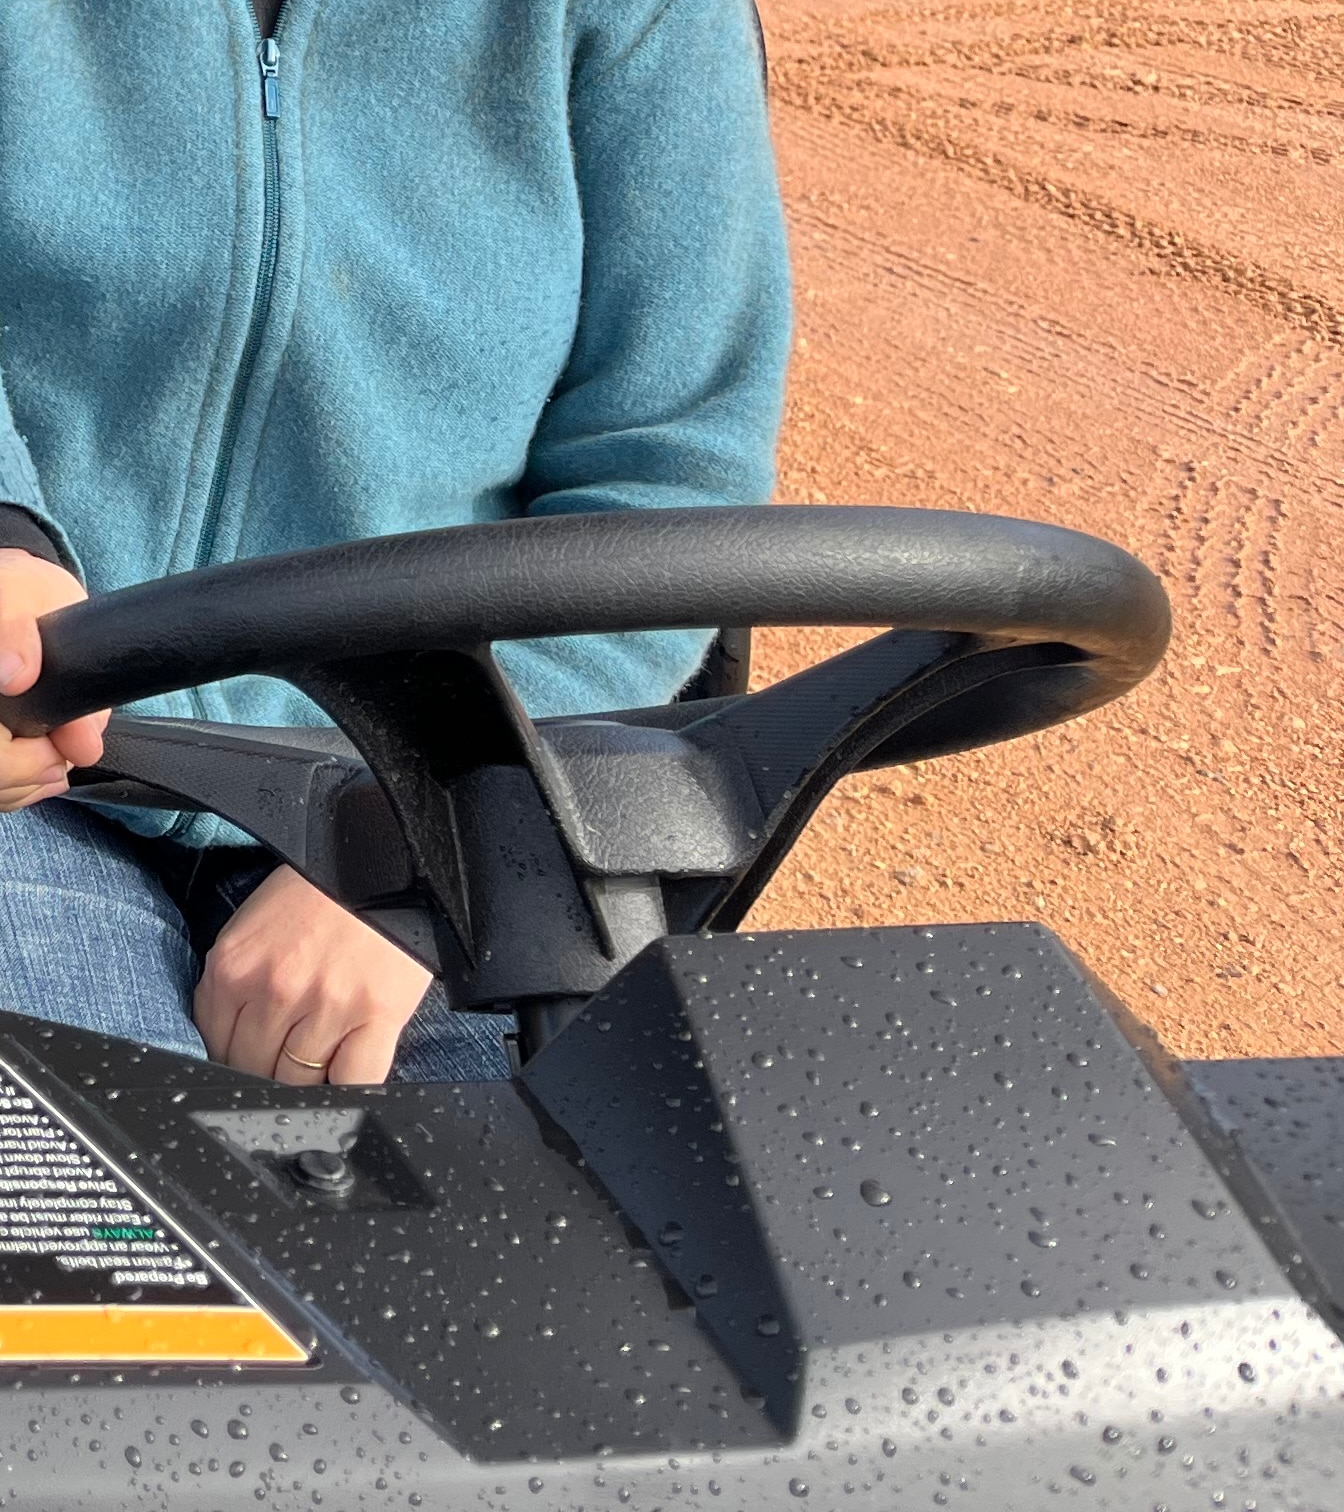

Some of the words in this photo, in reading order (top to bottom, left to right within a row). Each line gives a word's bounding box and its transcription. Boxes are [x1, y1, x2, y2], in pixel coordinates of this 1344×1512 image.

[26, 1139, 68, 1152] Avoid
[37, 1238, 108, 1254] approved
[108, 1241, 128, 1252] an
[130, 1241, 170, 1254] Wear
[113, 1271, 186, 1286] Prepared
